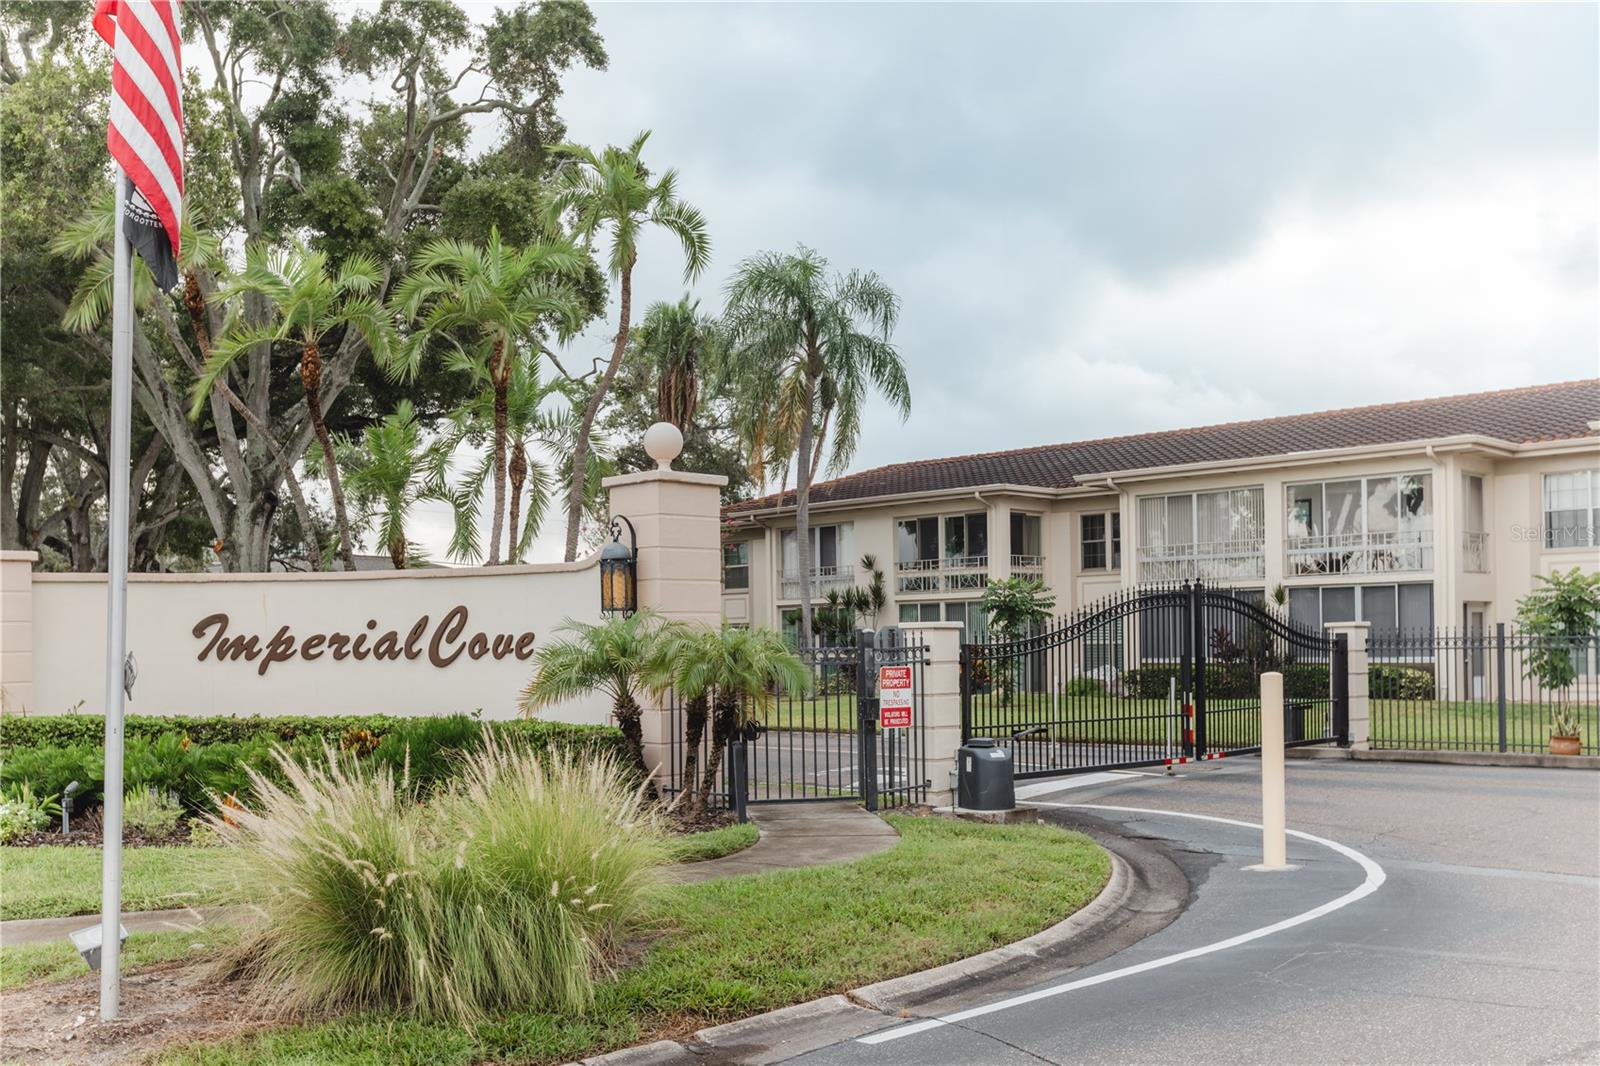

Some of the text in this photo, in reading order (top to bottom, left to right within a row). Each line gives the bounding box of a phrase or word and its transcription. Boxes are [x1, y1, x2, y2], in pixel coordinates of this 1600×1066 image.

[124, 208, 163, 228] ORGOTTE
[192, 605, 536, 677] Imperial Cove
[885, 669, 907, 678] PRIVATE
[882, 678, 910, 687] PROPERTY
